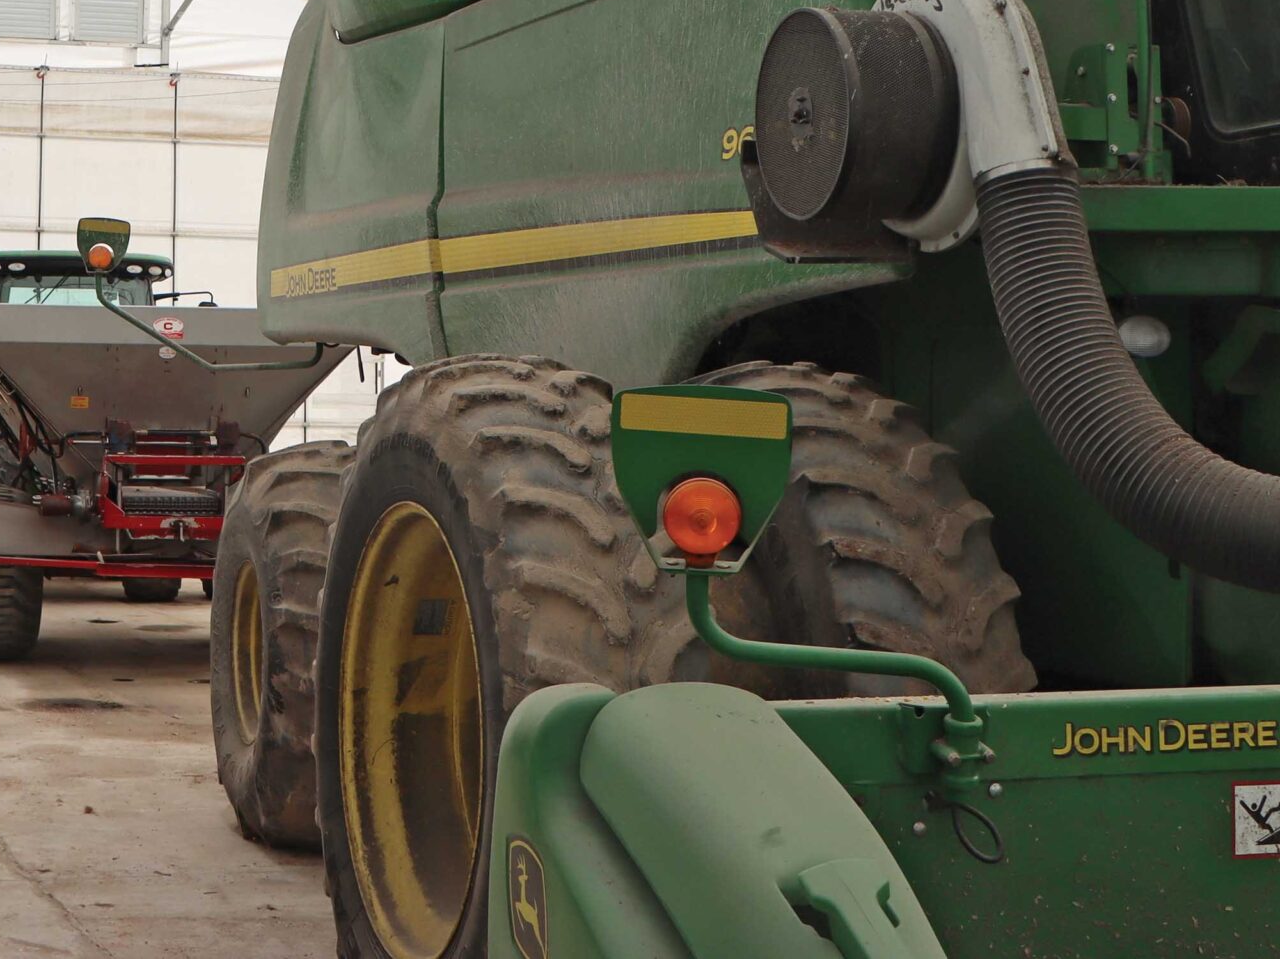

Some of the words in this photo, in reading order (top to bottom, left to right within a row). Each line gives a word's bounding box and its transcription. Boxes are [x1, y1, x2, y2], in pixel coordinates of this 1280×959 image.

[286, 272, 306, 295] JOHN
[307, 268, 337, 291] DEERE
[1052, 722, 1152, 756] JOHN
[1158, 718, 1278, 752] DEERE
